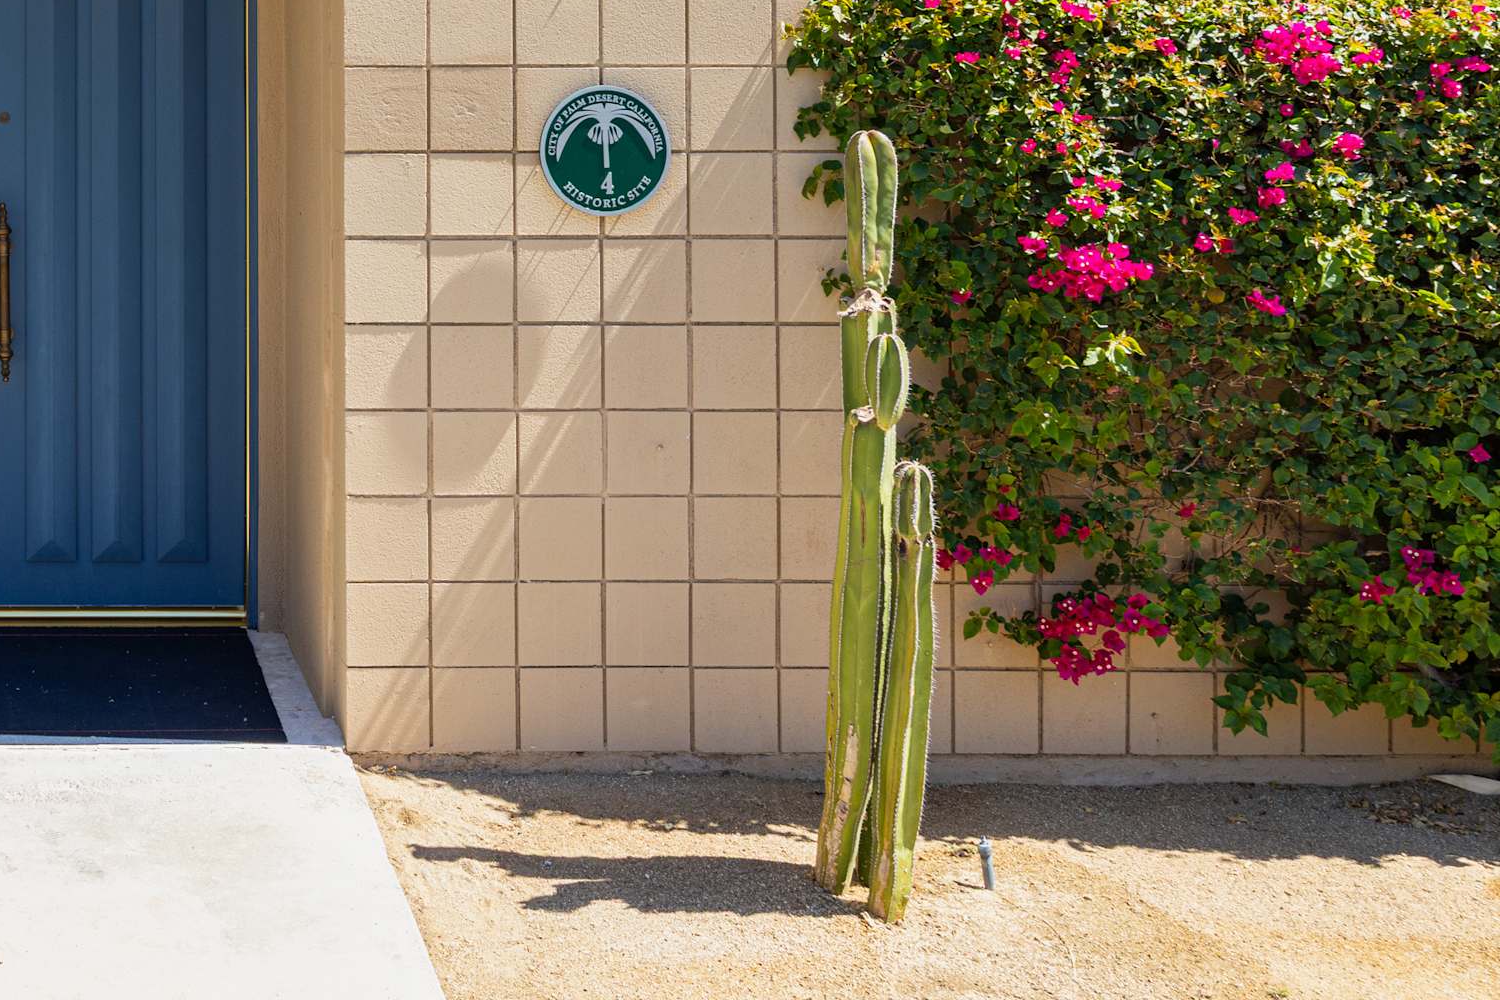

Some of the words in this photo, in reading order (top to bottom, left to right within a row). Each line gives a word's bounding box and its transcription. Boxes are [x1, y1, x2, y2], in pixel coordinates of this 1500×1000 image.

[547, 131, 559, 156] CITY
[553, 115, 565, 131] OF
[562, 98, 587, 119] PALM
[587, 94, 627, 105] DESERT
[626, 100, 664, 153] CALIFORNIA
[563, 181, 626, 208] HISTORIC
[627, 175, 652, 201] SITE
[600, 171, 615, 195] 4
